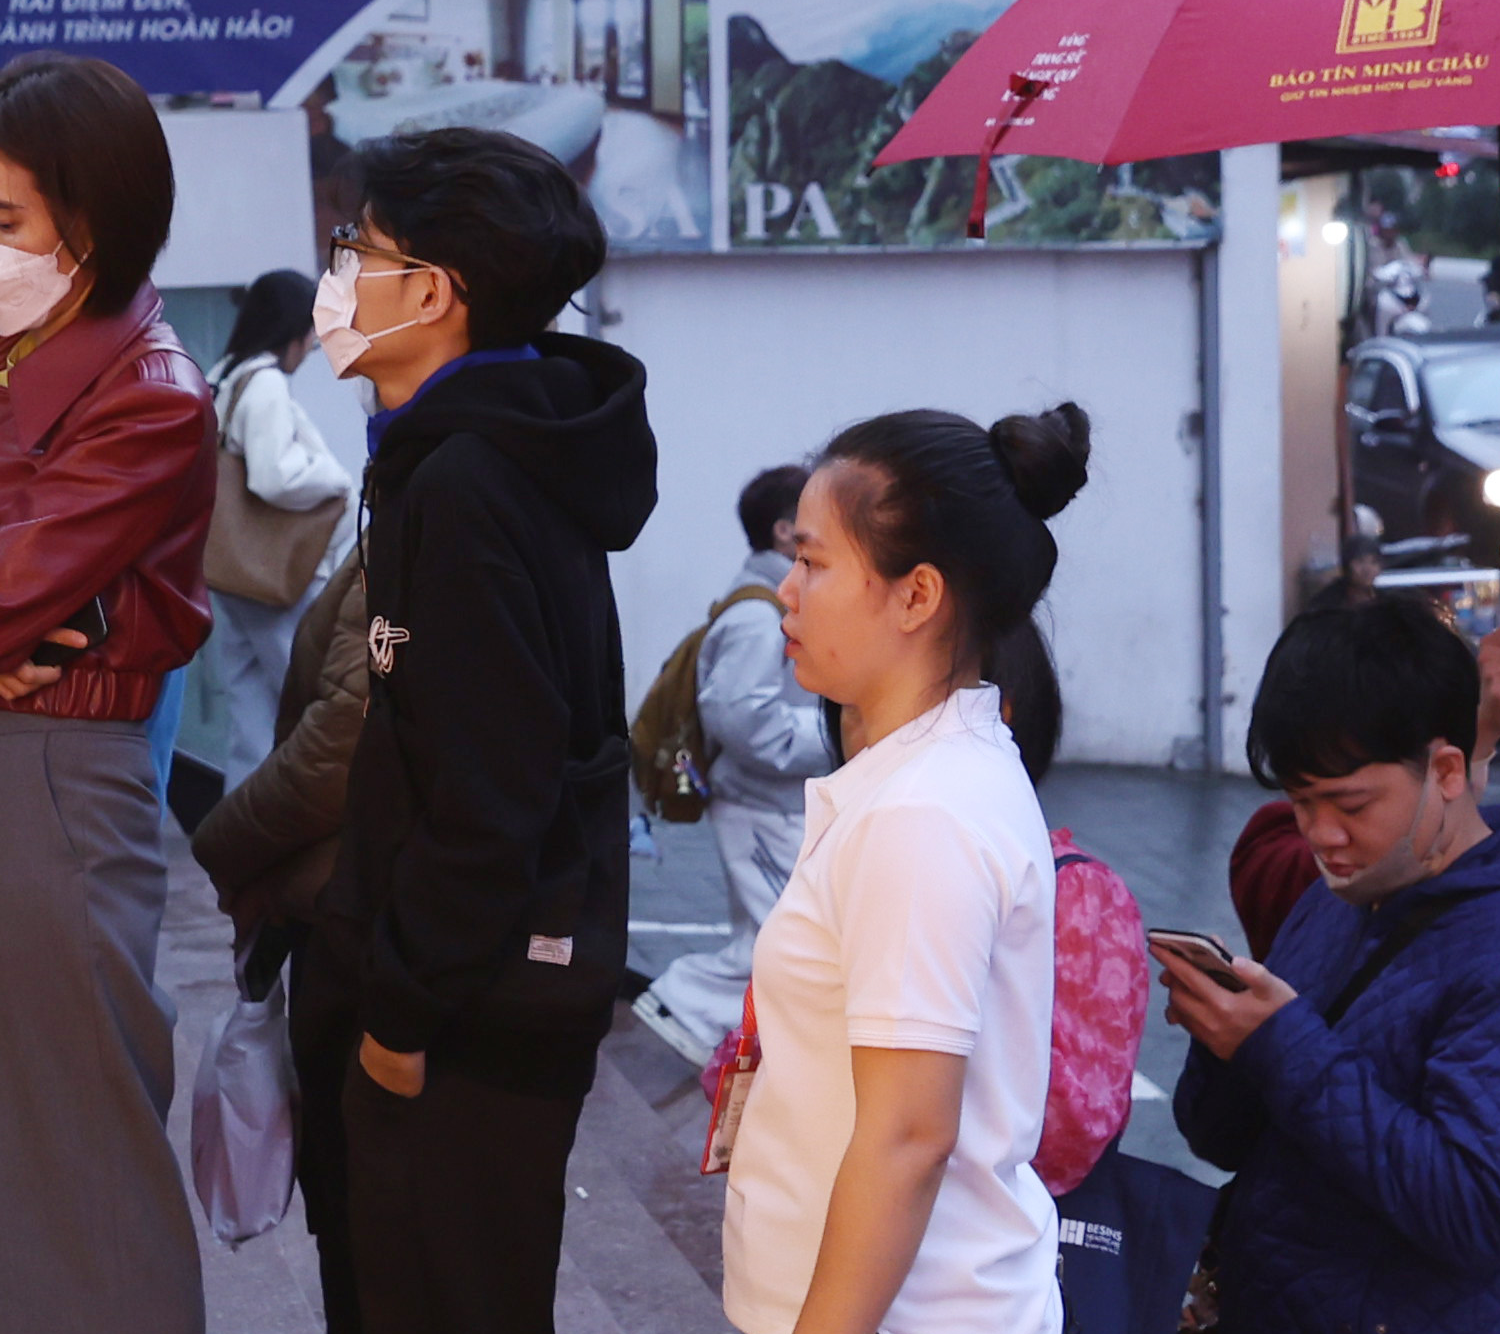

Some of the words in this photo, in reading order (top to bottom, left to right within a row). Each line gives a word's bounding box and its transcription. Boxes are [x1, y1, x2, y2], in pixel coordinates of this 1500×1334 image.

[63, 12, 136, 43] TRÌNH
[140, 10, 219, 42] HOÀN
[1269, 70, 1316, 88] BẢO
[1321, 64, 1357, 82] TÍN
[1362, 59, 1421, 78] MINH
[1426, 52, 1490, 72] CHÂU
